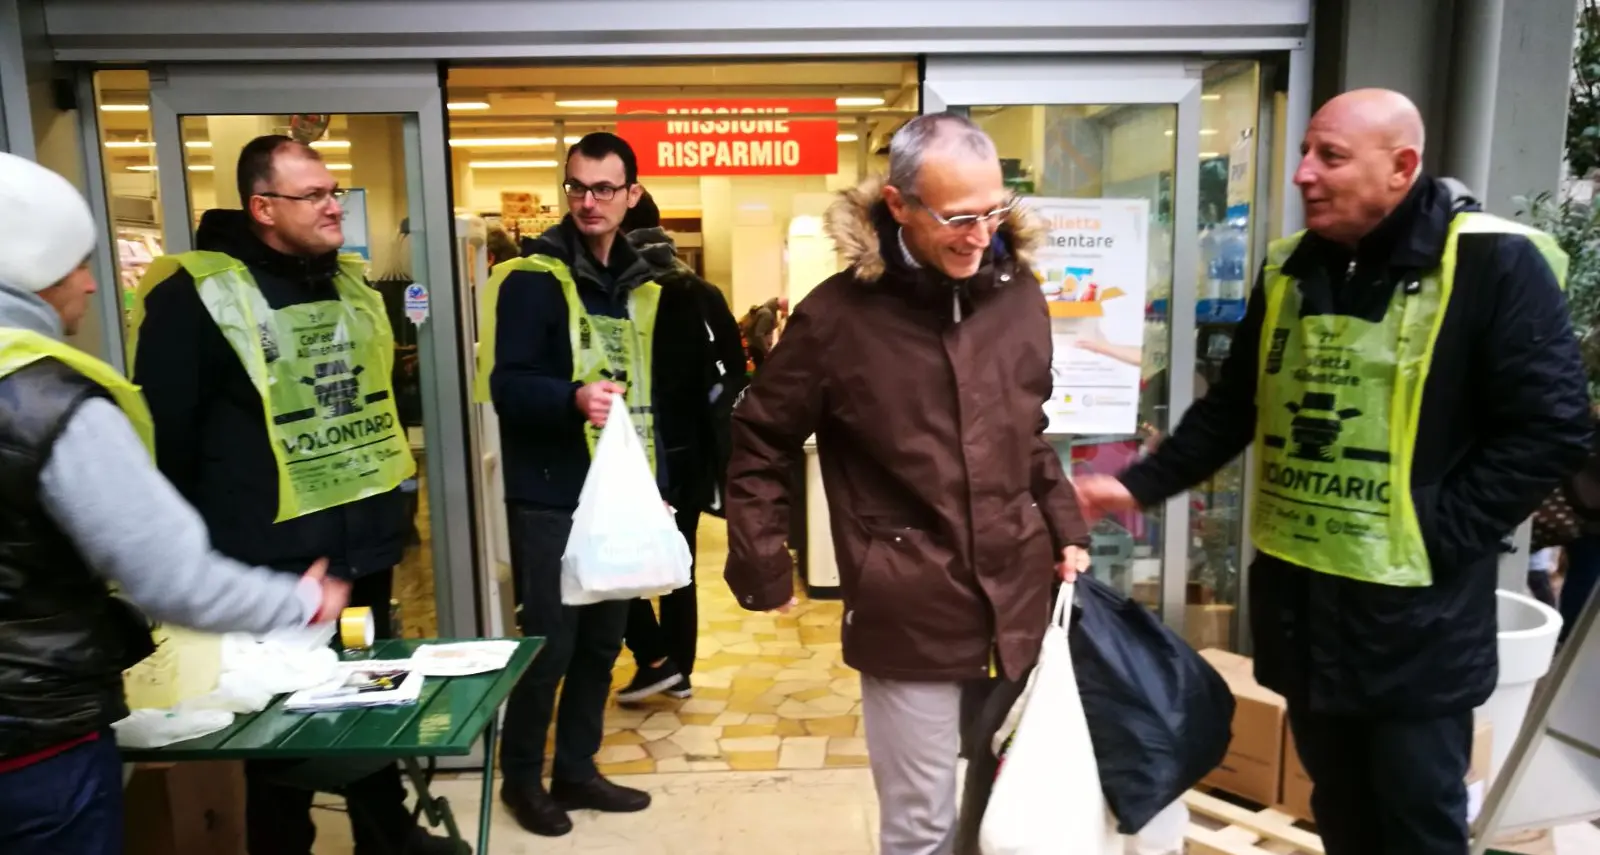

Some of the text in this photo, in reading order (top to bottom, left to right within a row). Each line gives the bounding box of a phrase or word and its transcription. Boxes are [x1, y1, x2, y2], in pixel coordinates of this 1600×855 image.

[667, 107, 789, 134] MISSIONE
[657, 140, 800, 167] RISPARMIO
[1041, 213, 1102, 232] olletta
[1046, 233, 1114, 249] mentare
